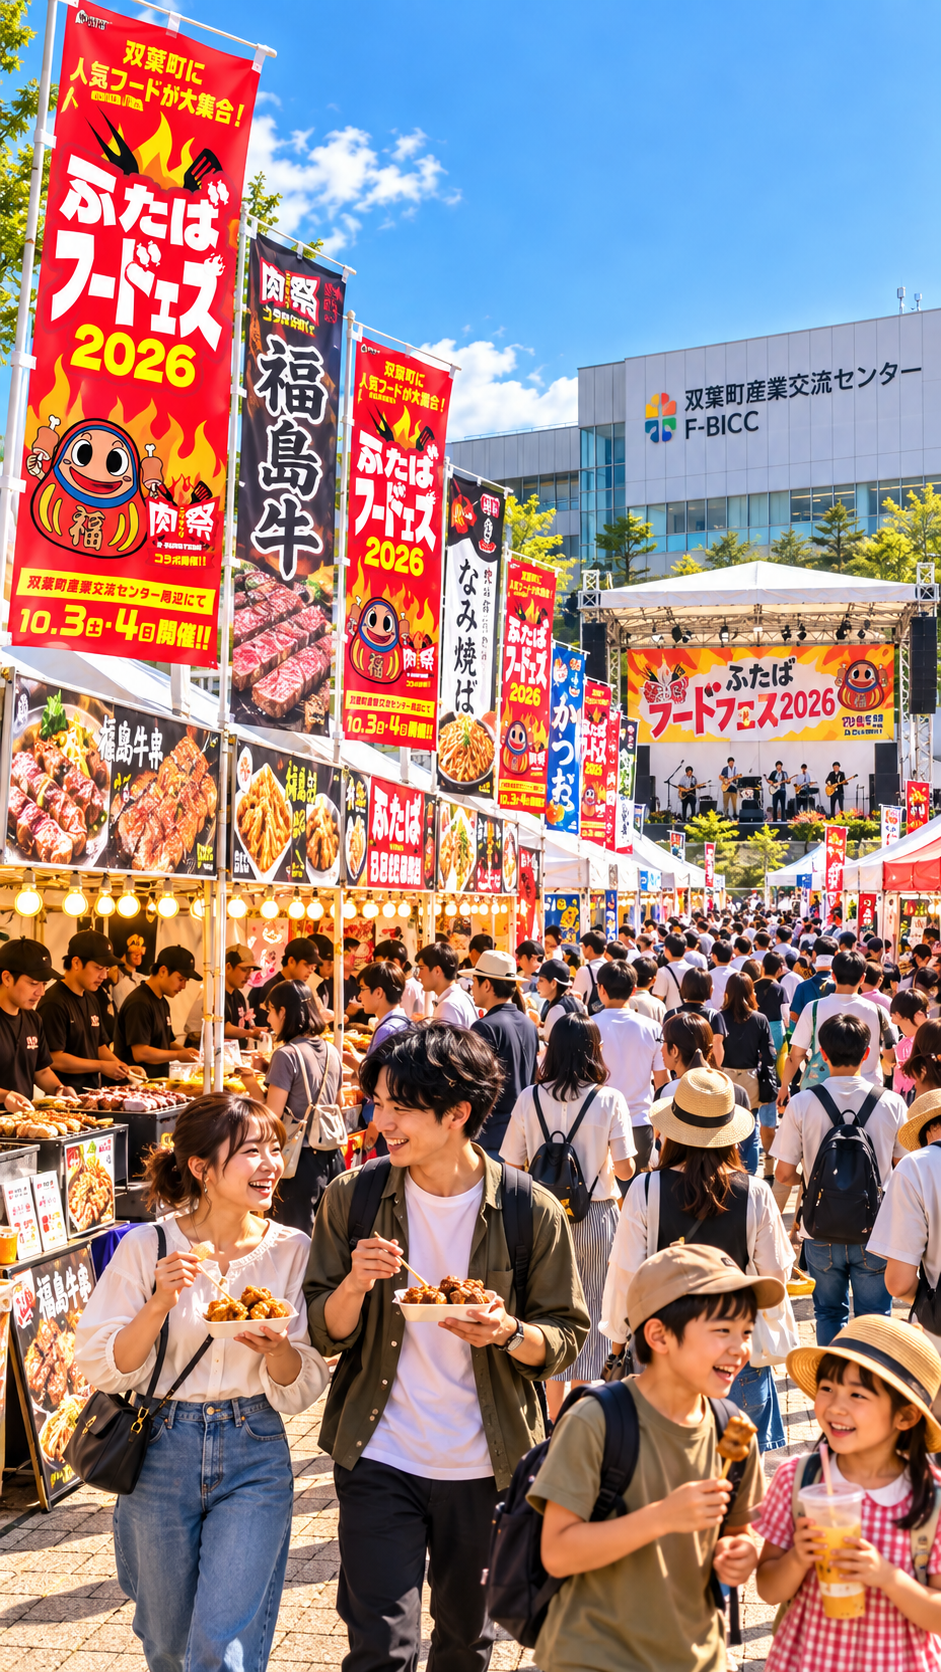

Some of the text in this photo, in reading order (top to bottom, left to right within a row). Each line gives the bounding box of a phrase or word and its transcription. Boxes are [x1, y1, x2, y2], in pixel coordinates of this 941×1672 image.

[123, 40, 206, 85] 双葉町に
[70, 57, 245, 127] 人気フードが大集合!
[59, 153, 229, 251] ふたば
[70, 323, 196, 387] 2026
[685, 361, 922, 411] 双葉町産業交流センター
[685, 411, 759, 439] F-BICC
[251, 334, 328, 580] 福島牛
[357, 430, 439, 489] ふたば
[69, 505, 105, 551] 福
[364, 536, 424, 577] 2026
[510, 682, 541, 707] 2026
[726, 657, 796, 692] ふたば
[372, 785, 421, 846] ふたば
